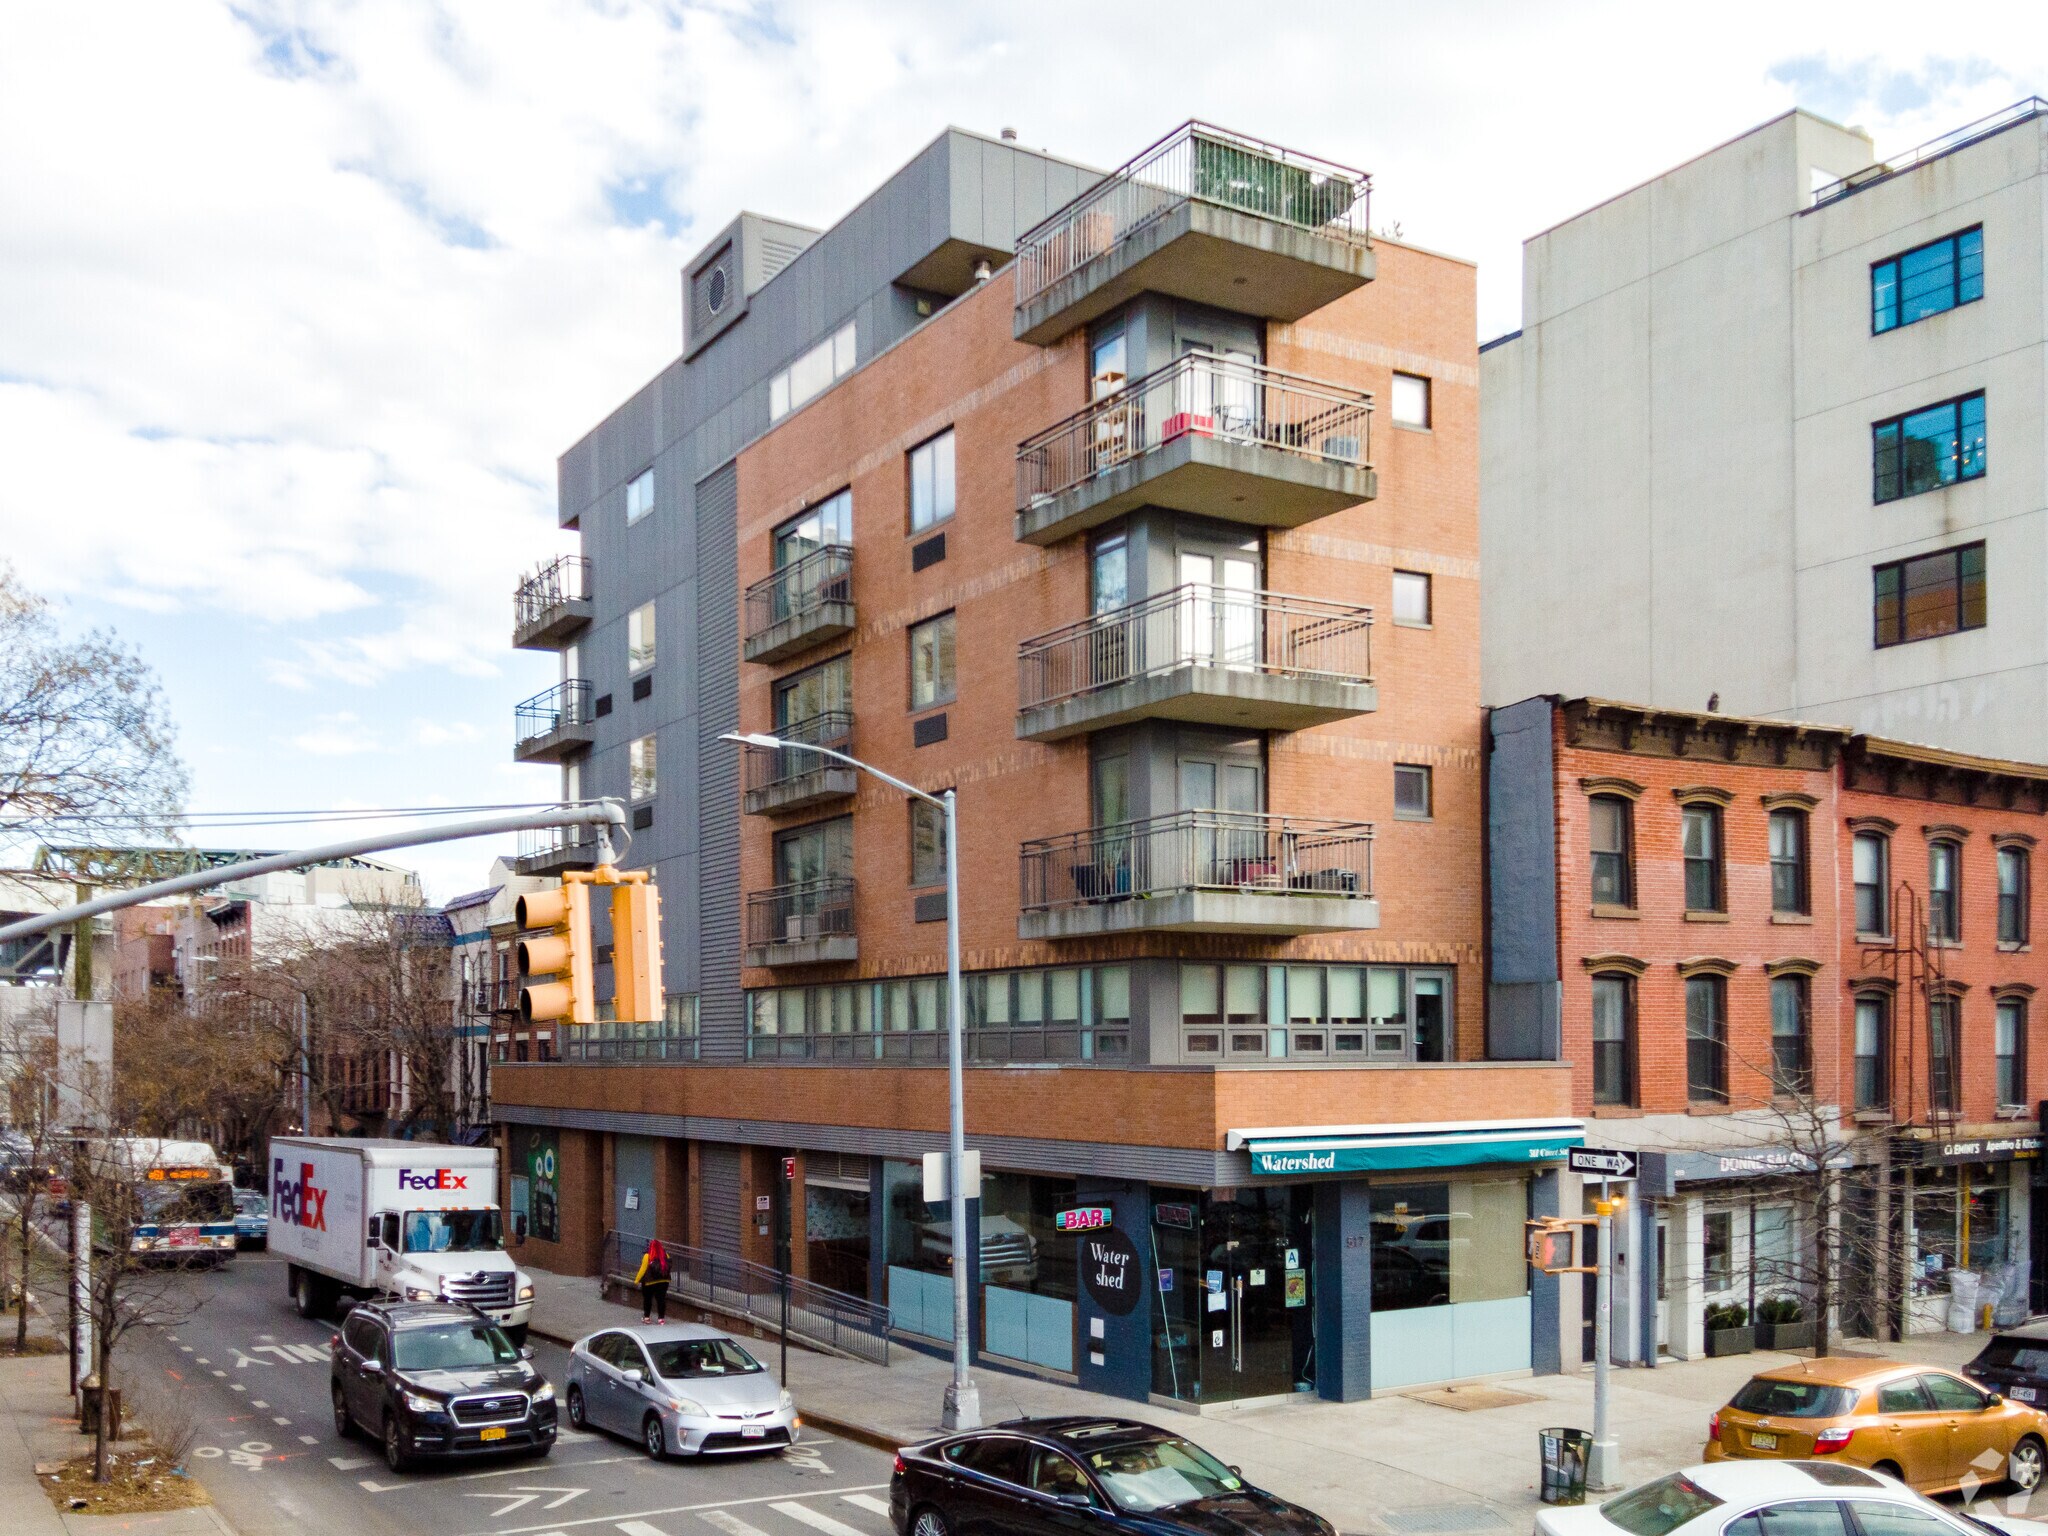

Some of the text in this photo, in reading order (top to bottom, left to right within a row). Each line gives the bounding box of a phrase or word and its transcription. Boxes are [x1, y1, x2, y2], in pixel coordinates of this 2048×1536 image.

[2015, 1138, 2021, 1149] &
[1261, 1151, 1335, 1171] Watershed
[1578, 1155, 1627, 1169] ONE WAY
[1720, 1157, 1764, 1172] DONNE
[399, 1168, 468, 1190] FedEx
[273, 1158, 327, 1232] FedEx
[1064, 1208, 1105, 1230] BAR
[1090, 1242, 1129, 1266] Water
[1288, 1251, 1297, 1263] A
[1096, 1264, 1124, 1289] shed
